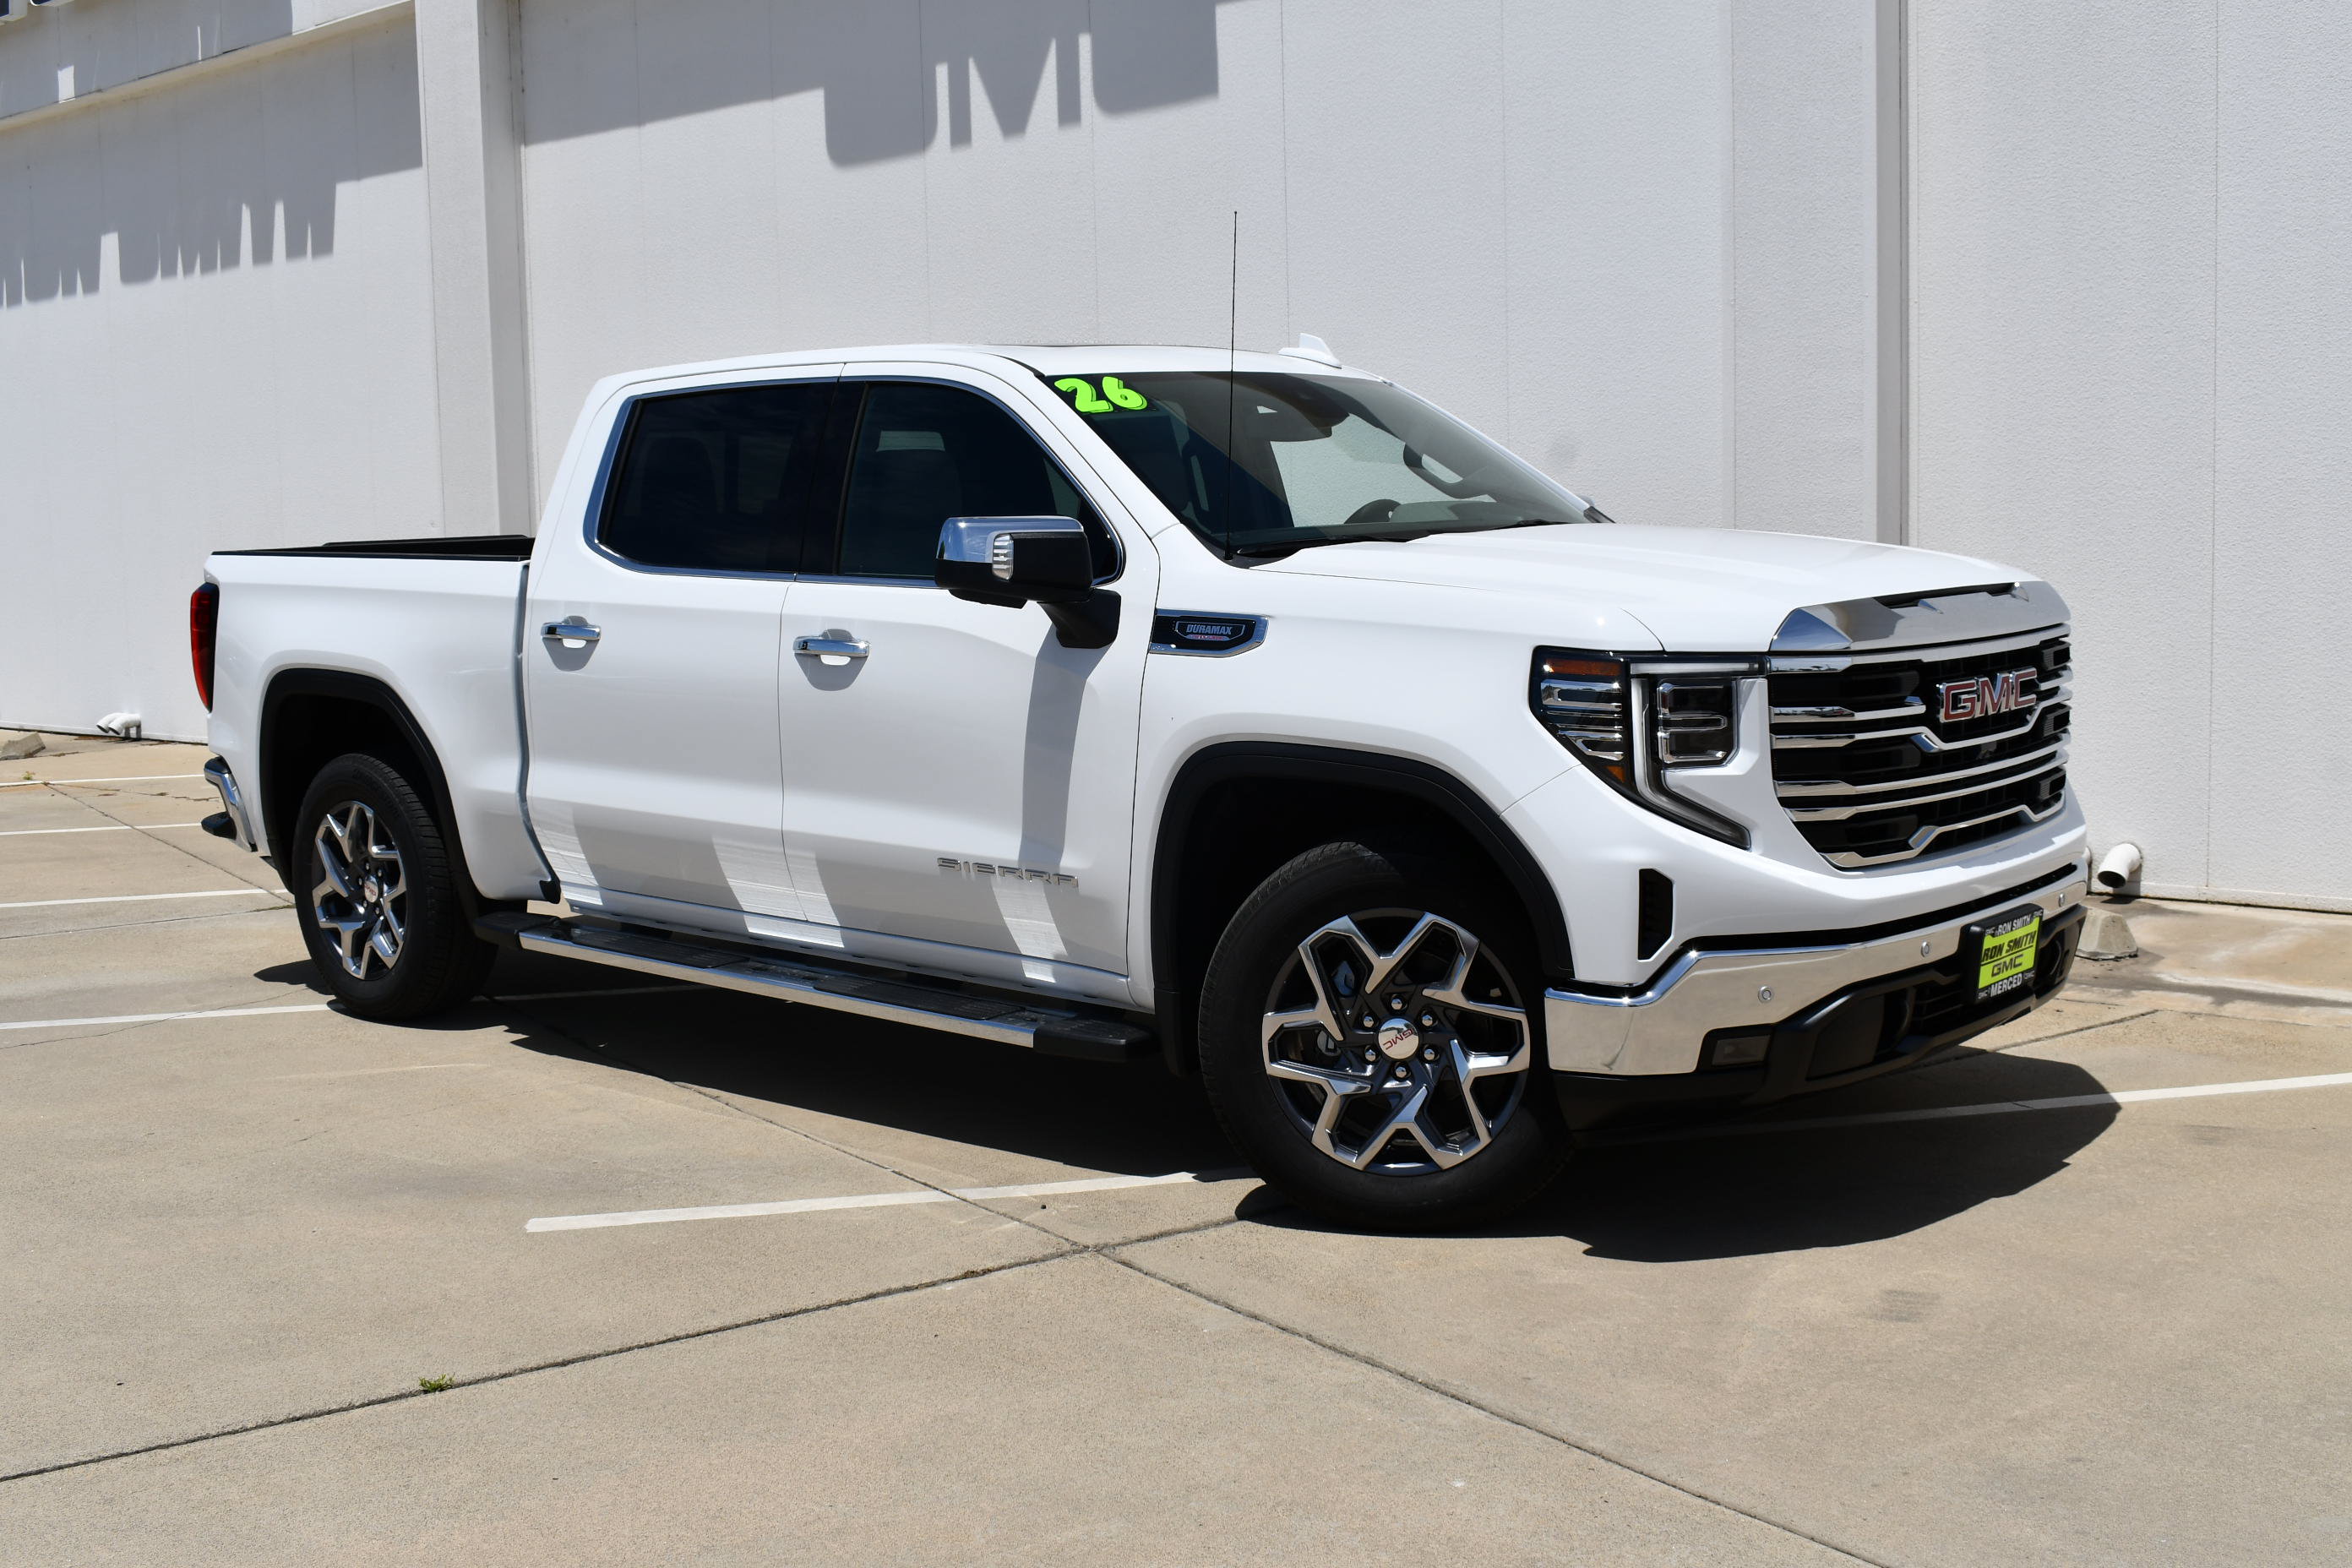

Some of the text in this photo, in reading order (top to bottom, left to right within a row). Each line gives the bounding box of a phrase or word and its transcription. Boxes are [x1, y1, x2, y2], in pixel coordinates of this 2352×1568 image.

[1054, 376, 1148, 413] 26
[1186, 624, 1233, 635] DURAMAX
[1939, 667, 2038, 723] GMC
[937, 858, 1079, 888] SIERRA
[1997, 914, 2031, 935] RON SMITH
[1982, 930, 2037, 962] RON SMITH
[1990, 954, 2023, 977] GMC
[1990, 973, 2023, 997] MERCED
[1382, 1029, 1413, 1050] GMC
